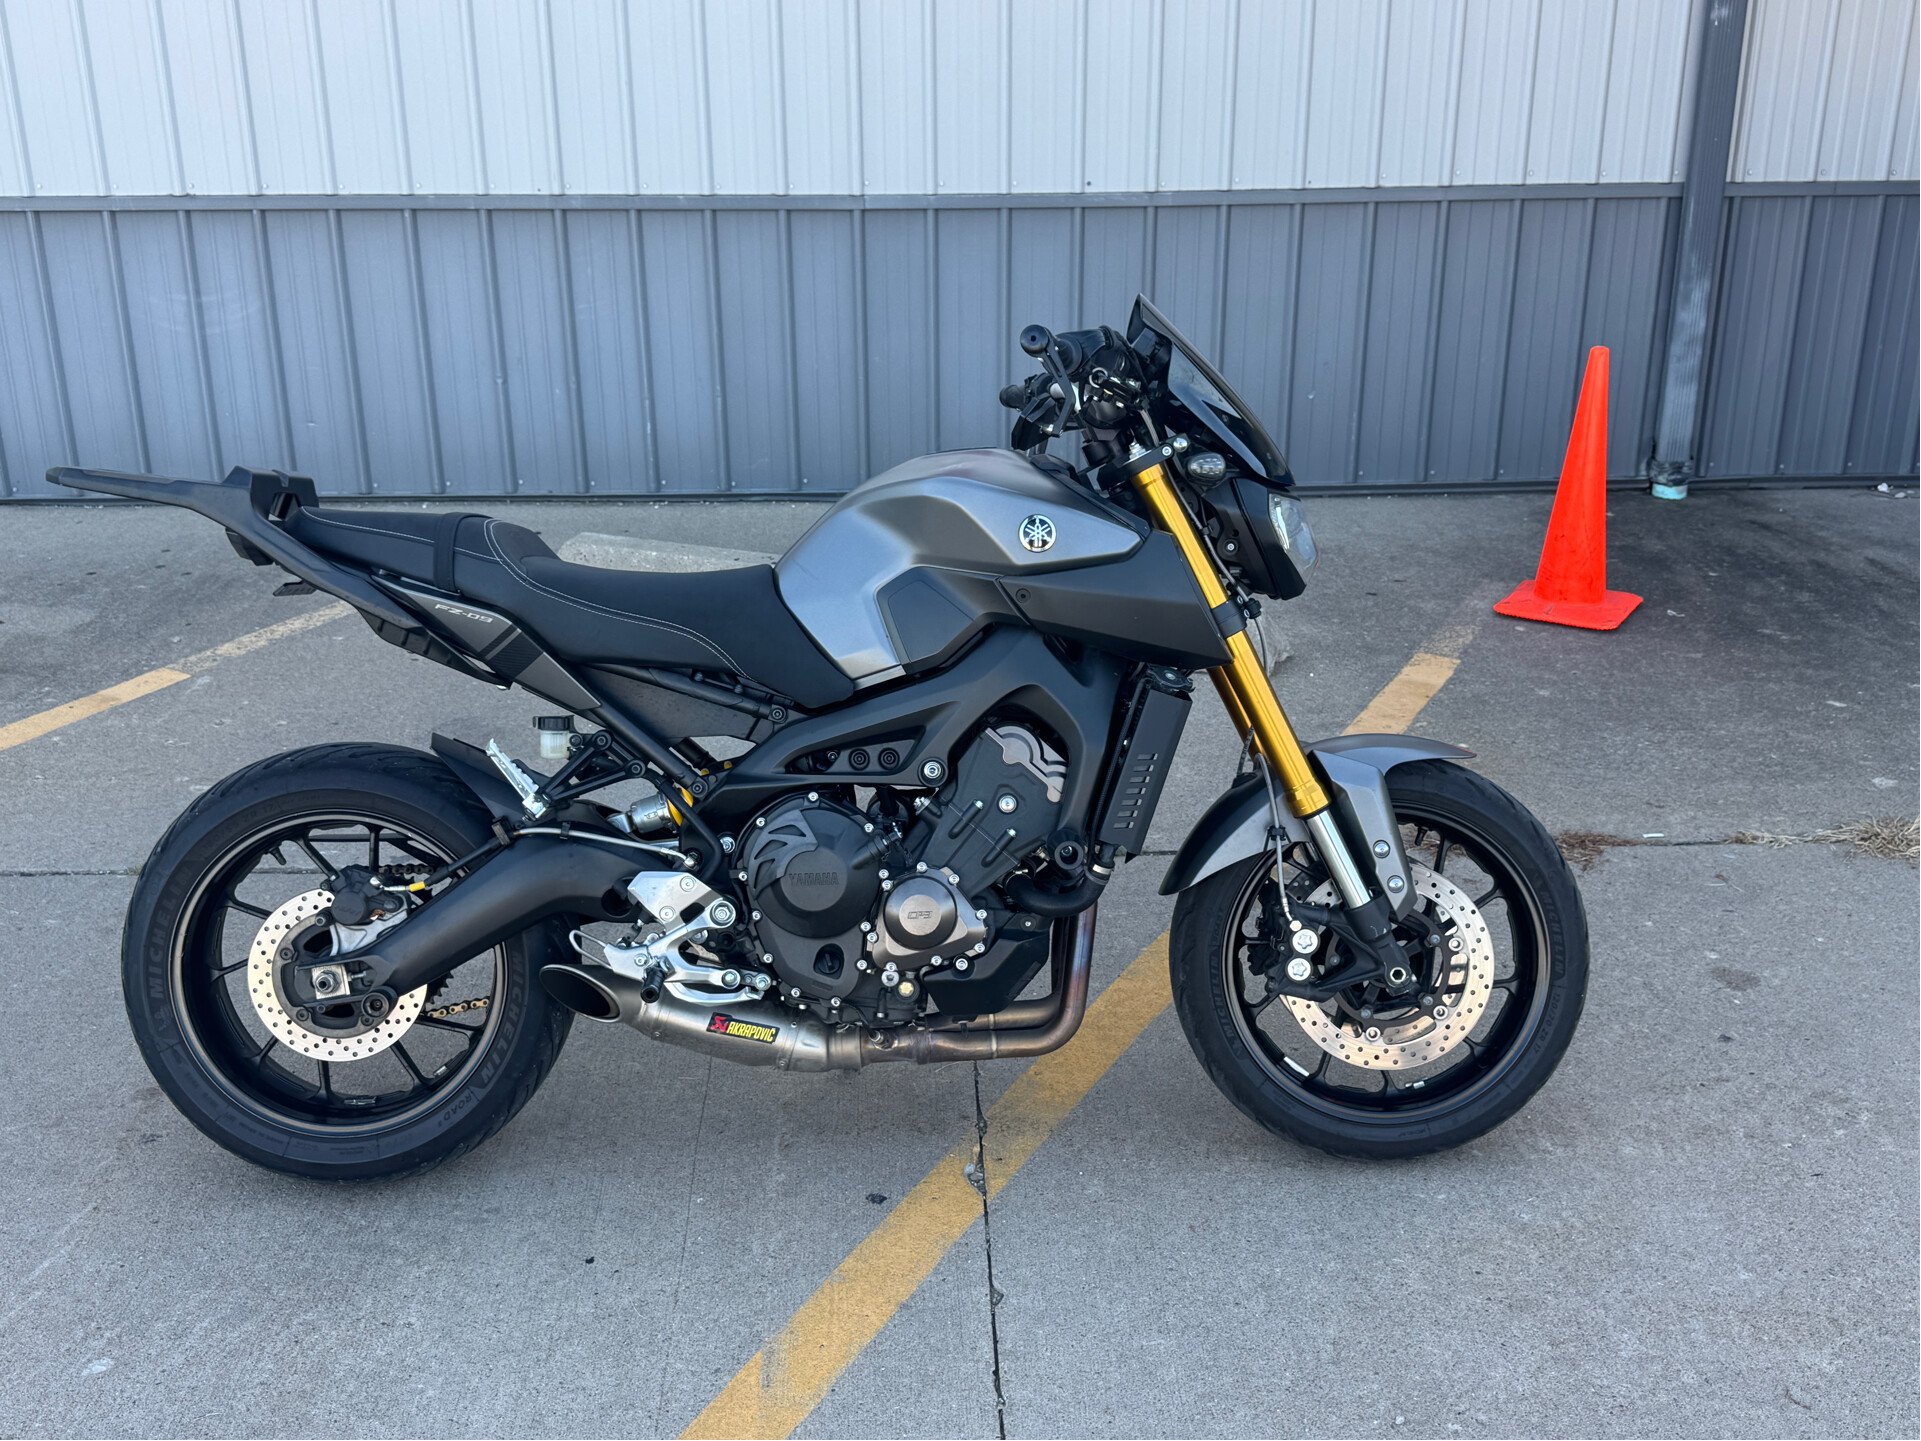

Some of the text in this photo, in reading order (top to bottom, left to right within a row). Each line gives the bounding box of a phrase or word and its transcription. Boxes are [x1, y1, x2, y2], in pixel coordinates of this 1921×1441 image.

[434, 603, 494, 624] FZ-09
[788, 872, 840, 888] YAMAHA
[147, 867, 191, 1000] MICHELIN
[1538, 888, 1564, 974] MICHELIN
[479, 949, 524, 1084] MICHELIN
